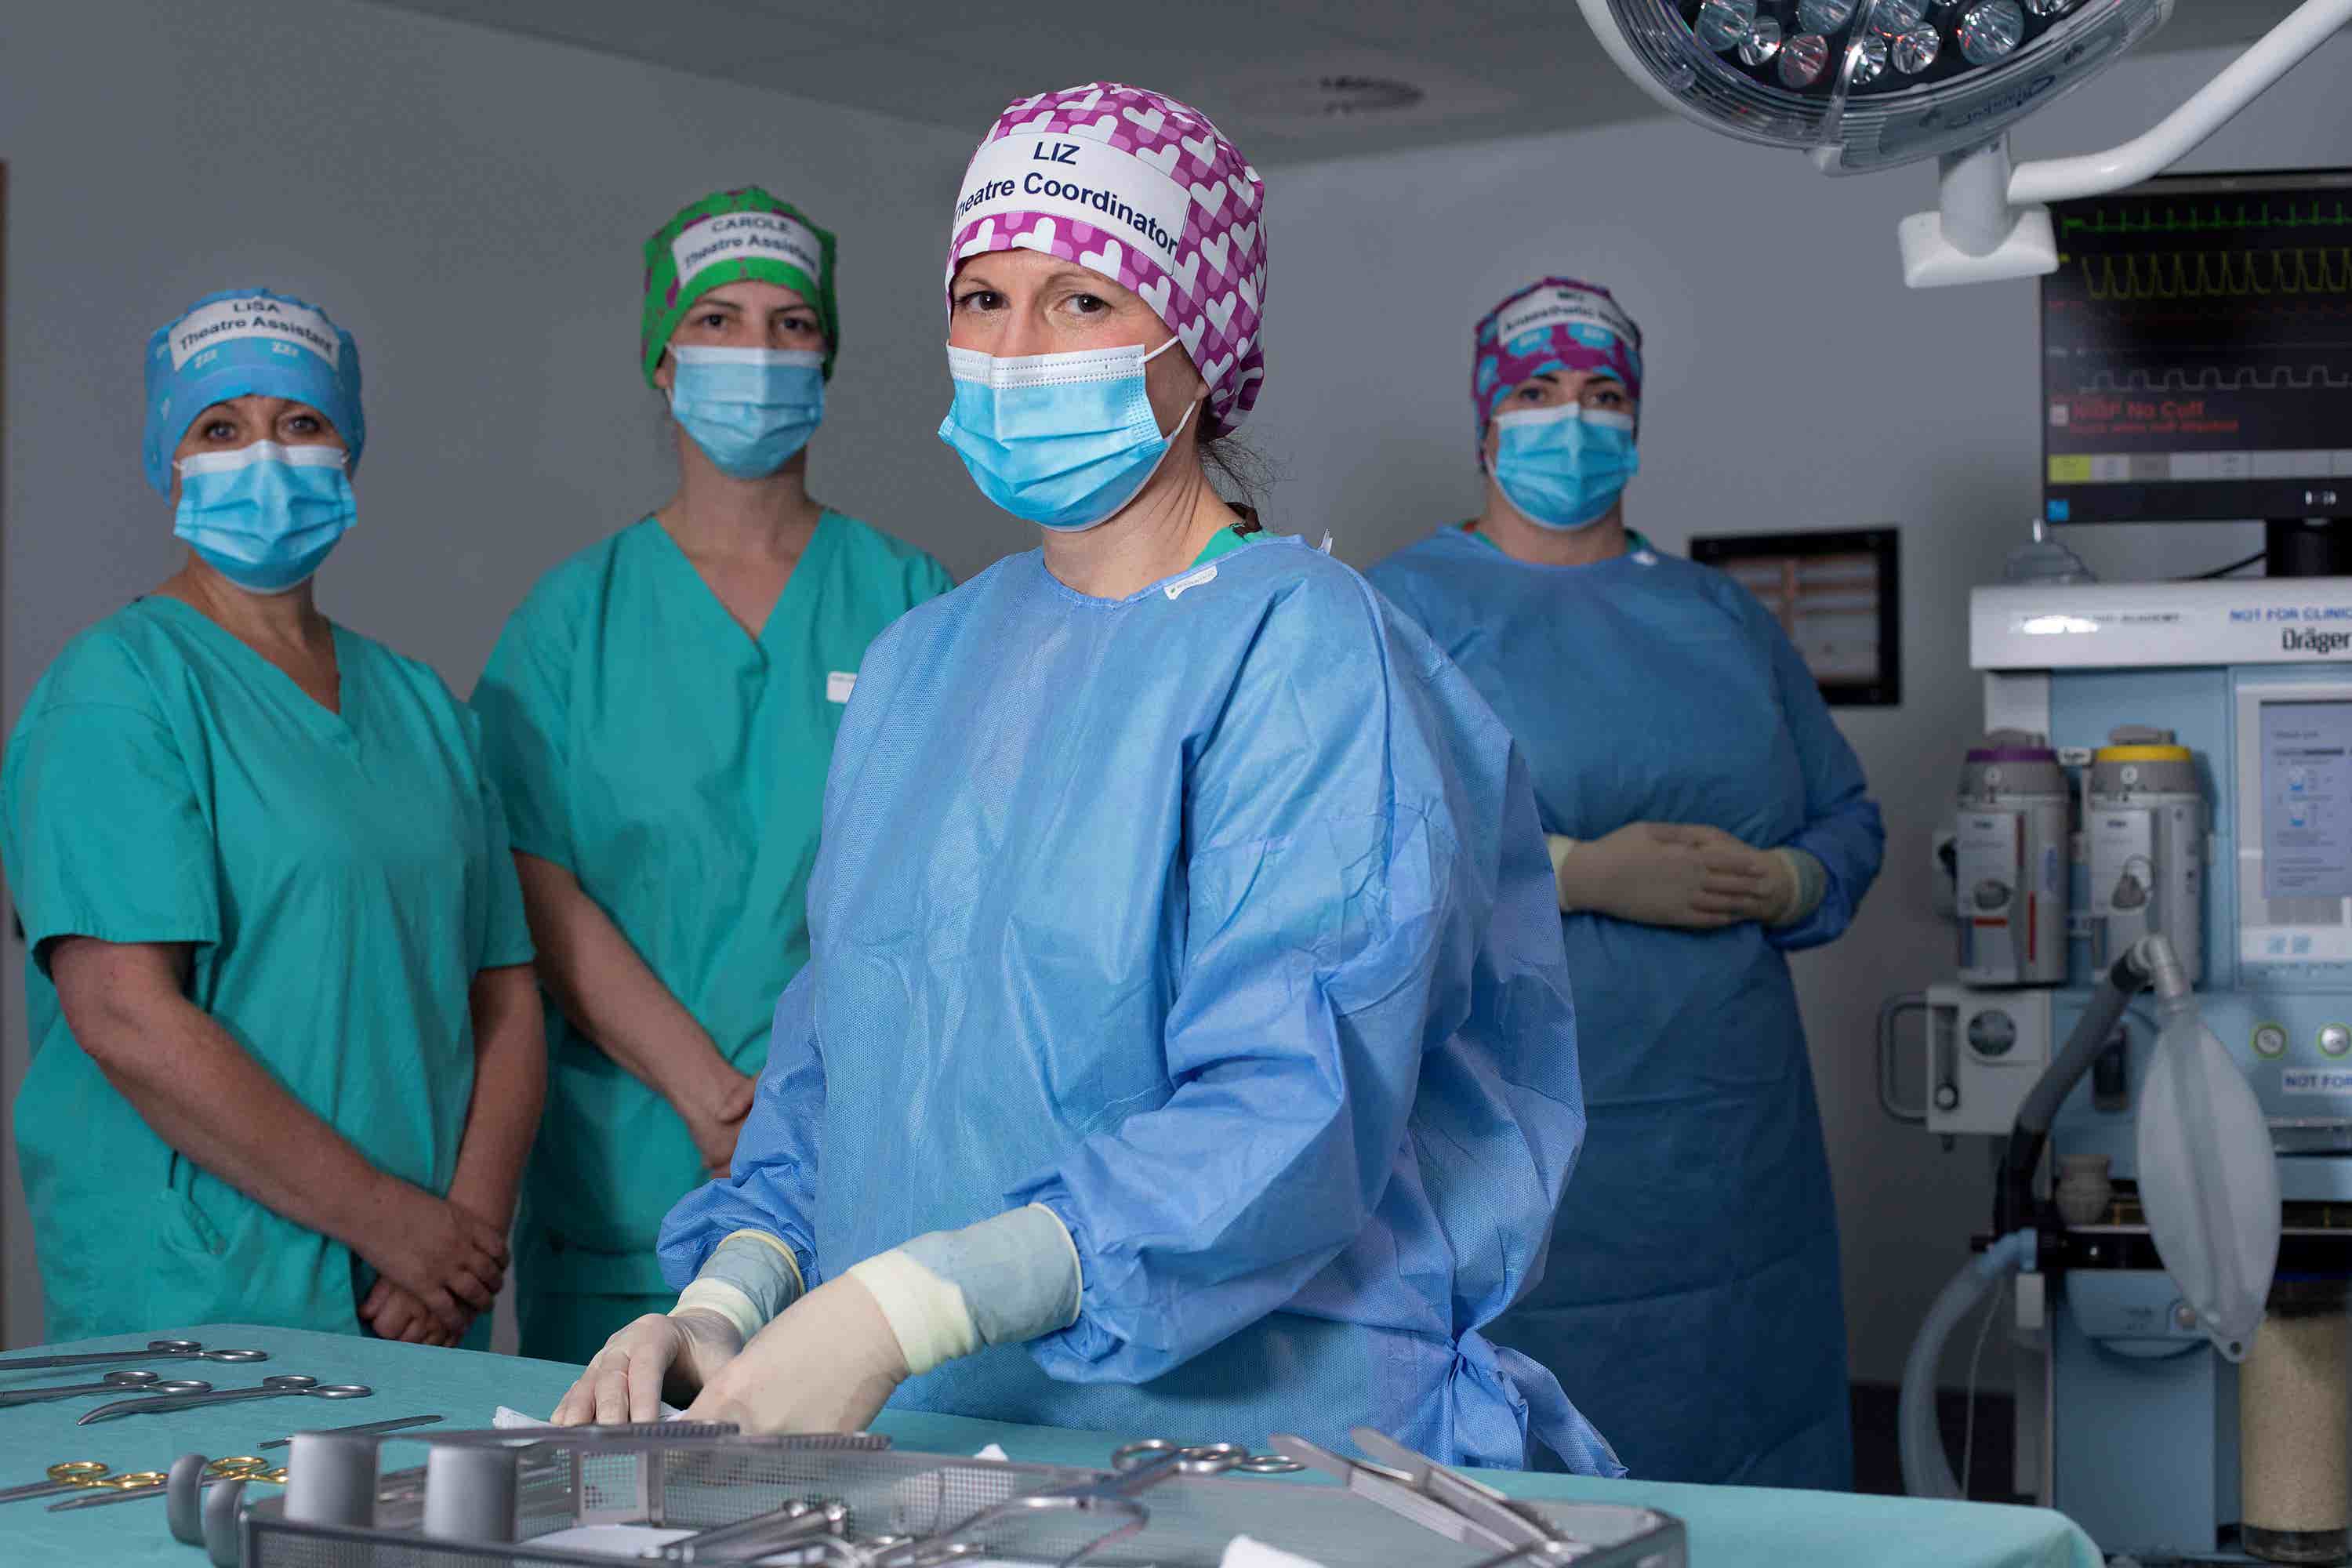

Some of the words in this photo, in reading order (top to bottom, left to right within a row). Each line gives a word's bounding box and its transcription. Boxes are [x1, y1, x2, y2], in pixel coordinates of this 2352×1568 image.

[1033, 141, 1081, 165] LIZ
[1023, 172, 1178, 256] Coordinator
[712, 217, 789, 232] CAROLE
[234, 300, 281, 313] LISA
[180, 318, 247, 350] Theatre
[252, 316, 333, 352] Assistant
[2230, 608, 2261, 622] NOT
[2266, 608, 2299, 622] FOR
[2282, 626, 2350, 655] Dräger
[2285, 1075, 2318, 1088] NOT
